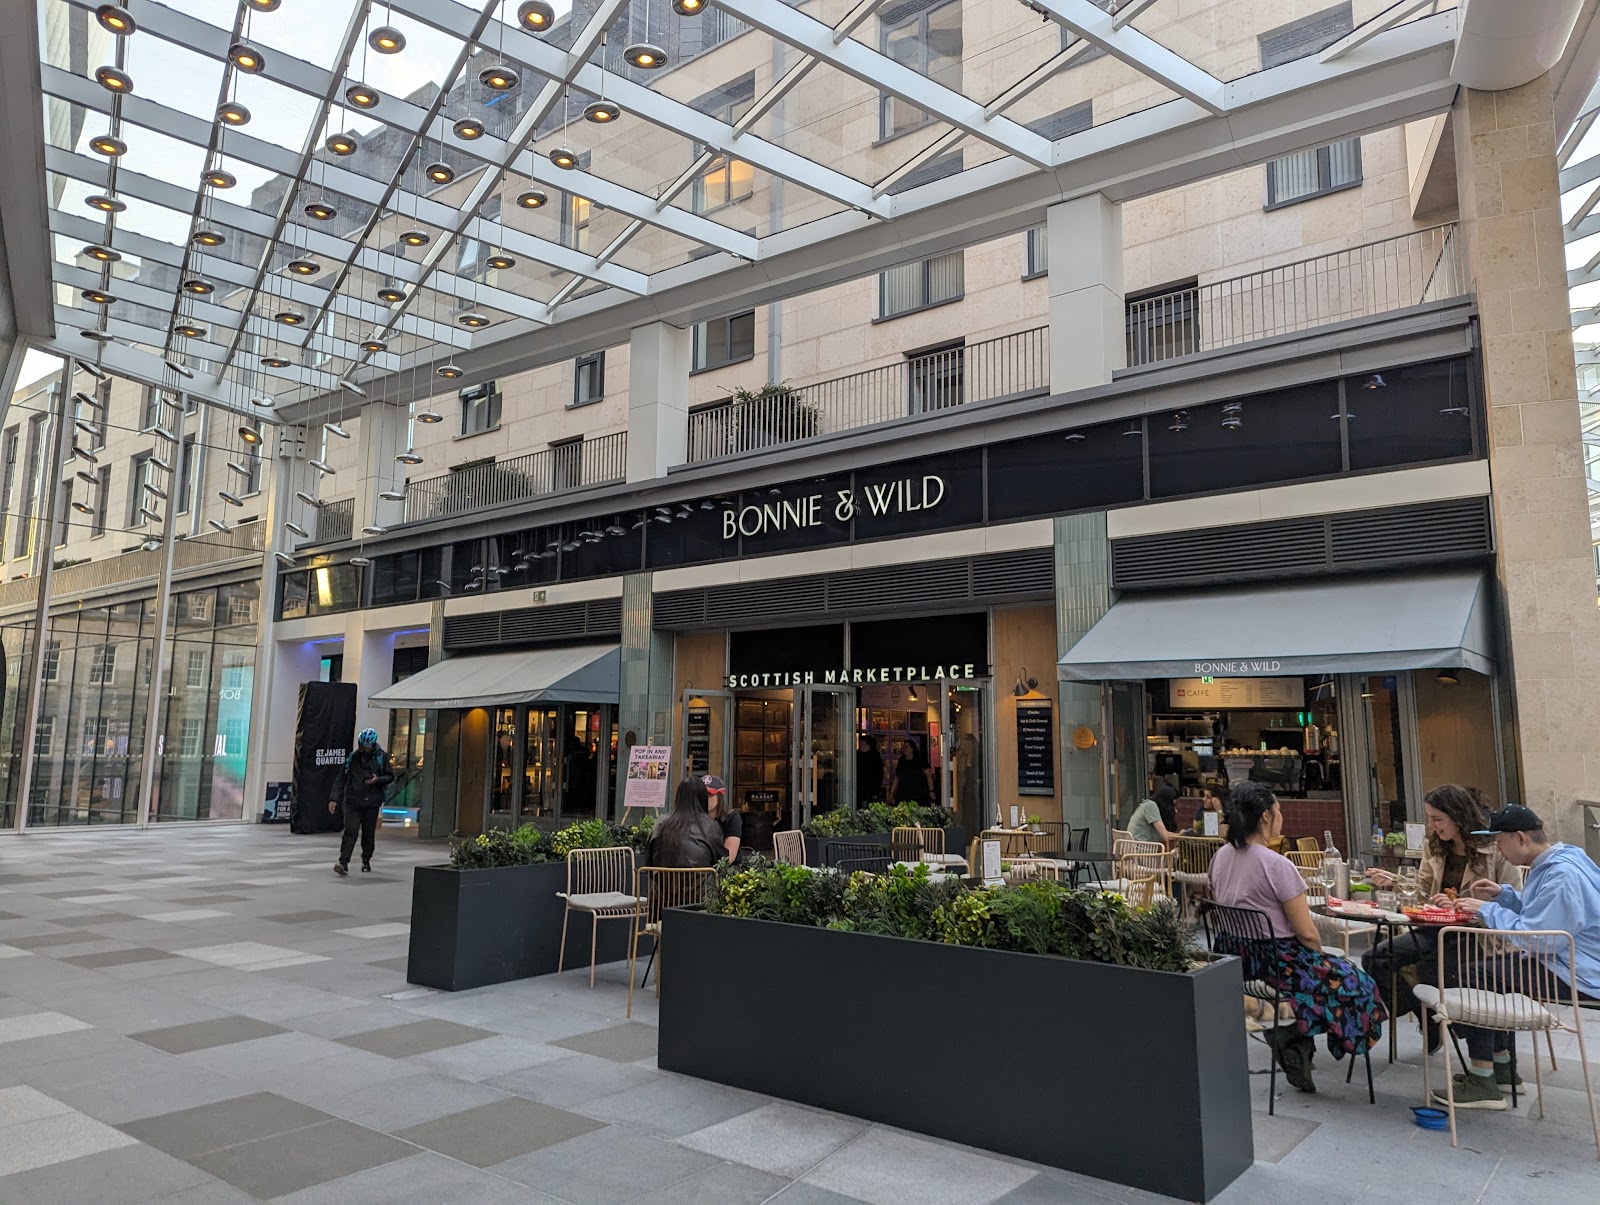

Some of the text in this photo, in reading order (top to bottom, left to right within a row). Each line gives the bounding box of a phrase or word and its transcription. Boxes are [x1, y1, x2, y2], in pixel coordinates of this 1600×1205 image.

[723, 475, 944, 539] BONNIE & WILD
[1194, 661, 1281, 673] BONNIE & WILD
[729, 664, 974, 688] SCOTTISH MARKETPLACE
[324, 748, 346, 757] JAMES
[315, 757, 346, 766] QUARTER
